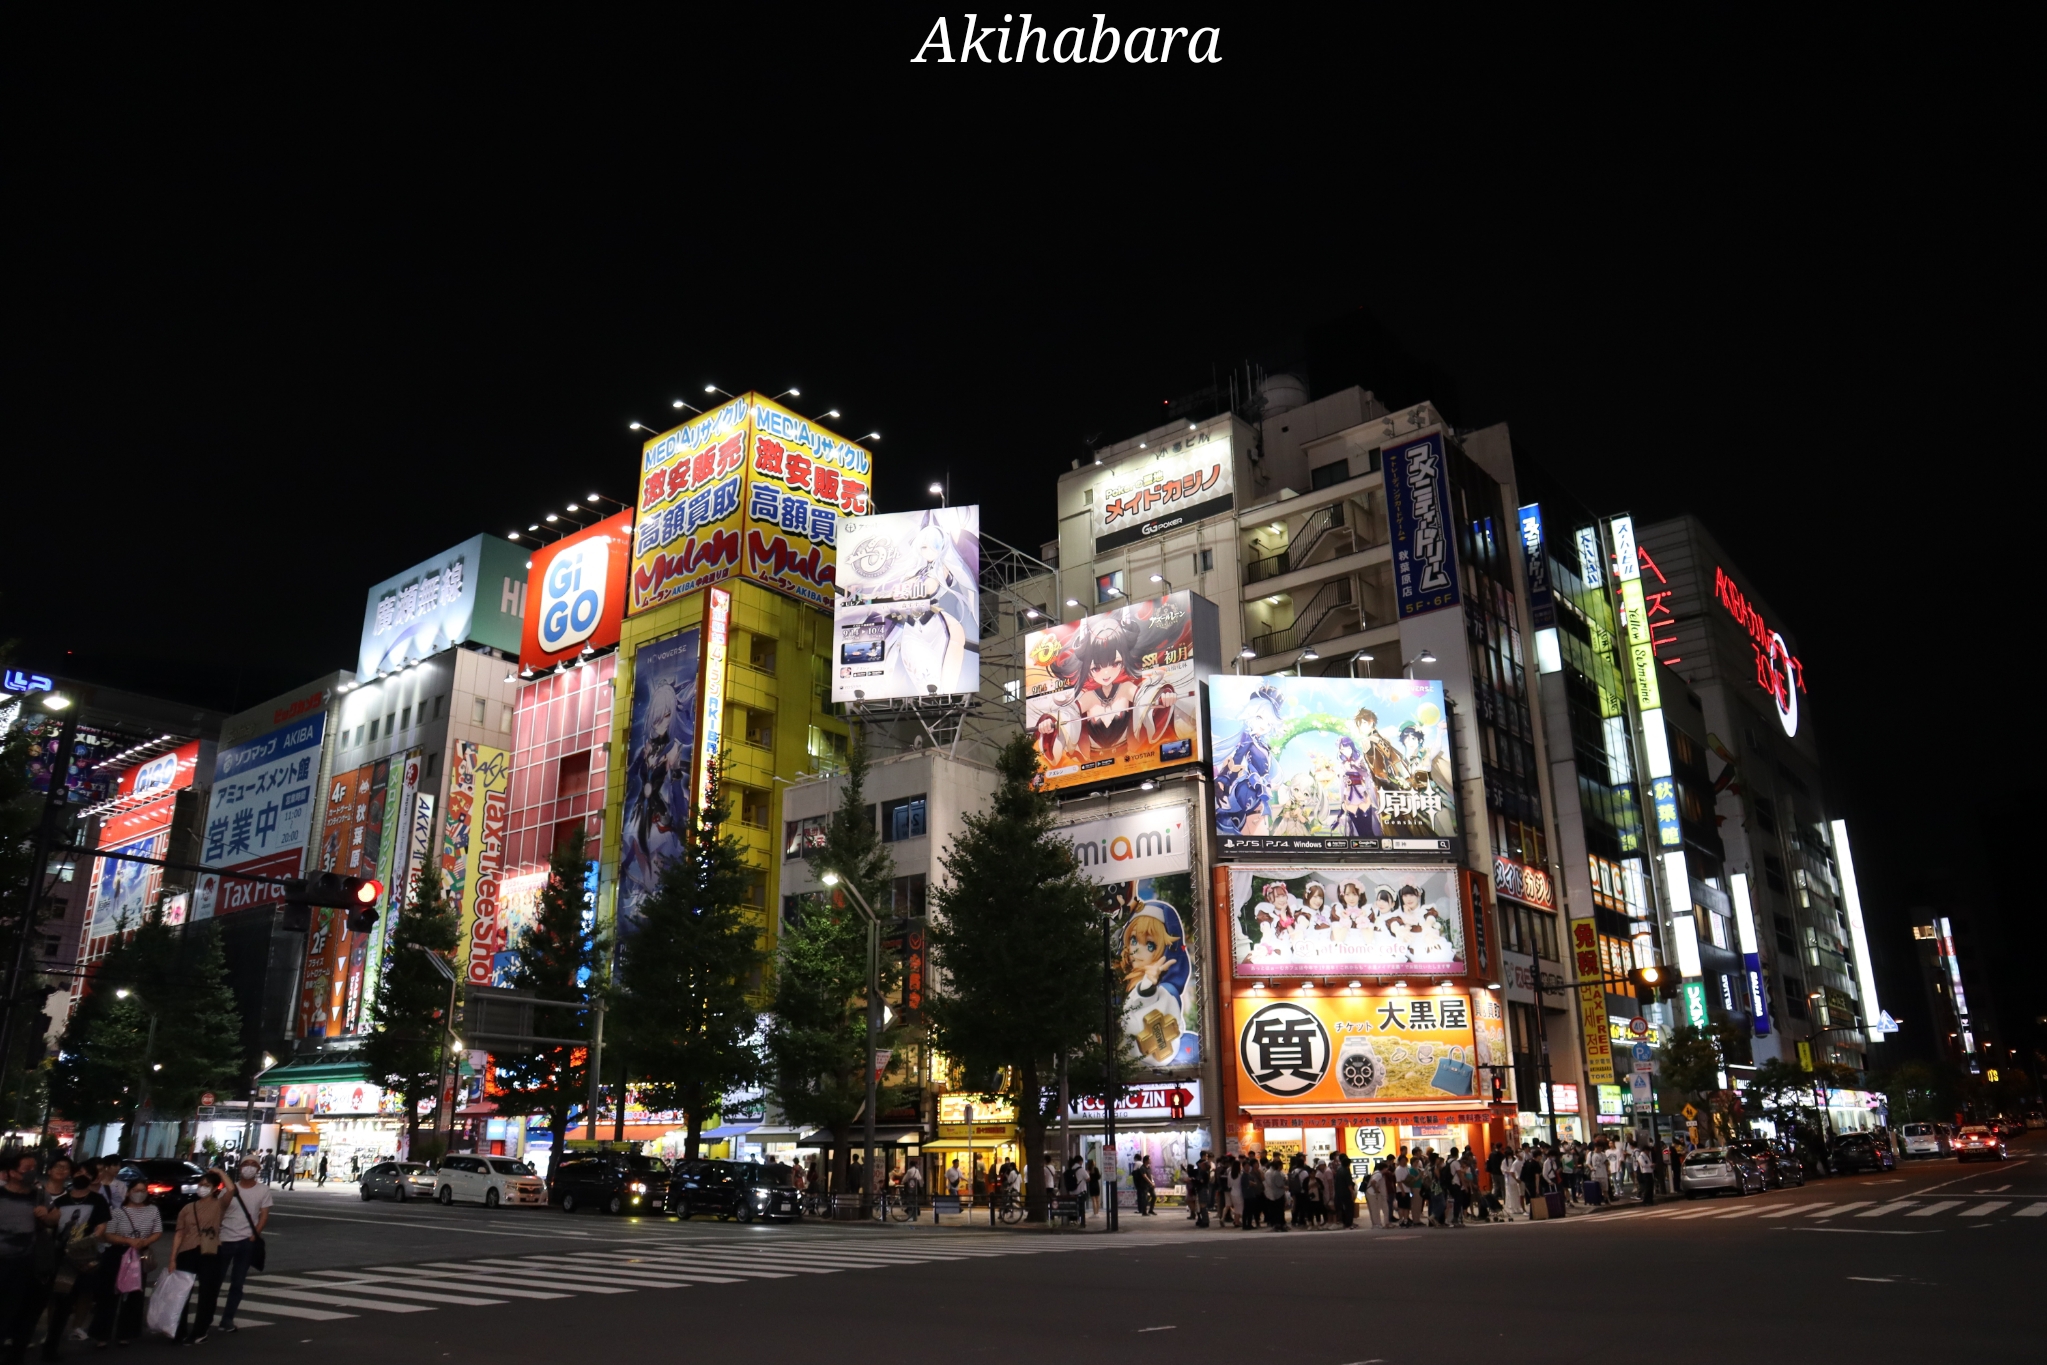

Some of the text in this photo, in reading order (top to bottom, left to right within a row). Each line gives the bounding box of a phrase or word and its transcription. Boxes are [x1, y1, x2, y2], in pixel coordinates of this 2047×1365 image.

[641, 430, 746, 511] 激安販売
[755, 434, 869, 515] 激安販売
[1105, 463, 1221, 524] メイドカジノ
[636, 474, 742, 558] 高額買取
[750, 483, 838, 546] 高額買
[633, 528, 742, 609] Mulan
[748, 529, 837, 587] Mula
[1634, 648, 1651, 704] Submarine
[235, 724, 314, 767] ソフマップ AKIBA
[1131, 751, 1156, 761] YOSTAR
[215, 756, 312, 810] アミューズメント館
[331, 781, 347, 804] 4F
[1377, 777, 1442, 831] 原神
[204, 800, 280, 864] 営業中
[1654, 780, 1680, 846] 秋葉館
[1294, 840, 1323, 849] Windows
[223, 881, 253, 909] Tax
[310, 931, 326, 955] 2F
[1573, 922, 1600, 977] 免税
[1335, 1021, 1373, 1033] チケット
[1377, 999, 1469, 1031] 大黒屋
[1634, 1021, 1645, 1031] 40
[1251, 1016, 1324, 1086] 質
[1082, 1111, 1129, 1119] Akihaara
[1142, 1090, 1166, 1108] ZIN
